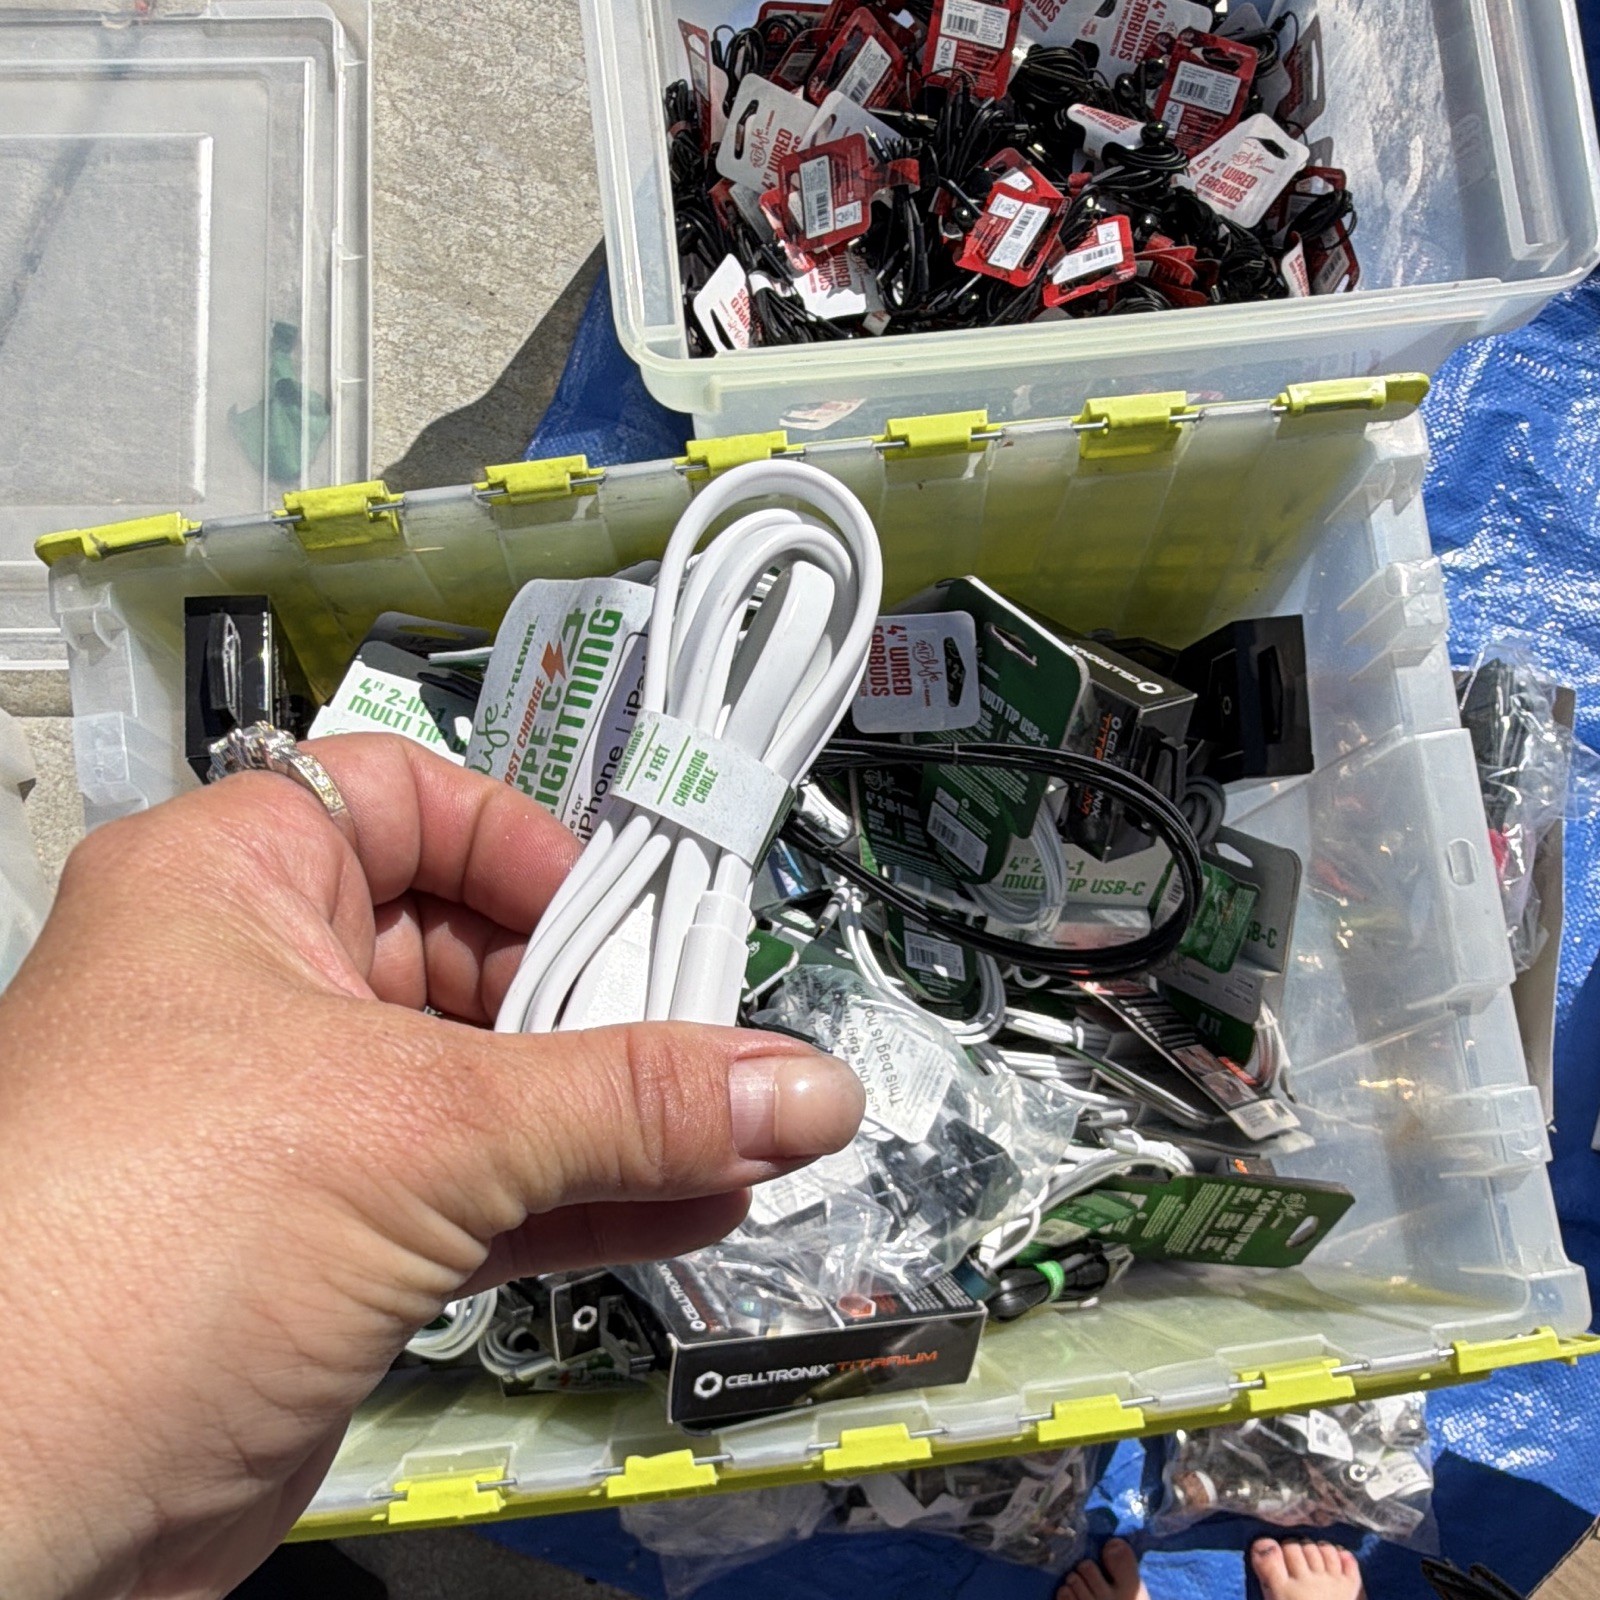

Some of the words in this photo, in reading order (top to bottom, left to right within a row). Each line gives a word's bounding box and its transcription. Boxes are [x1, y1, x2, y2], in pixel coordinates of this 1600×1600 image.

[1199, 173, 1248, 203] EARBUDS
[1222, 165, 1259, 190] WIRED
[869, 625, 891, 698] EARBUDS
[889, 646, 913, 696] WIRED
[347, 694, 413, 732] MULTI
[416, 720, 449, 744] TIP
[501, 702, 512, 719] by
[504, 748, 521, 787] AST
[516, 676, 546, 749] CHARGE
[516, 725, 551, 796] YPE
[540, 685, 562, 712] C
[649, 743, 671, 773] FEET
[644, 769, 658, 783] 3
[672, 748, 709, 807] CHARGING
[692, 766, 719, 804] CABLE
[571, 793, 584, 817] for
[577, 745, 624, 842] iPhone
[1089, 878, 1146, 897] USB-C
[1247, 920, 1278, 949] B-C
[876, 1043, 894, 1074] bag
[886, 1074, 904, 1108] This
[724, 1363, 832, 1390] CELLTRONIX
[835, 1350, 938, 1373] TITANIUM
